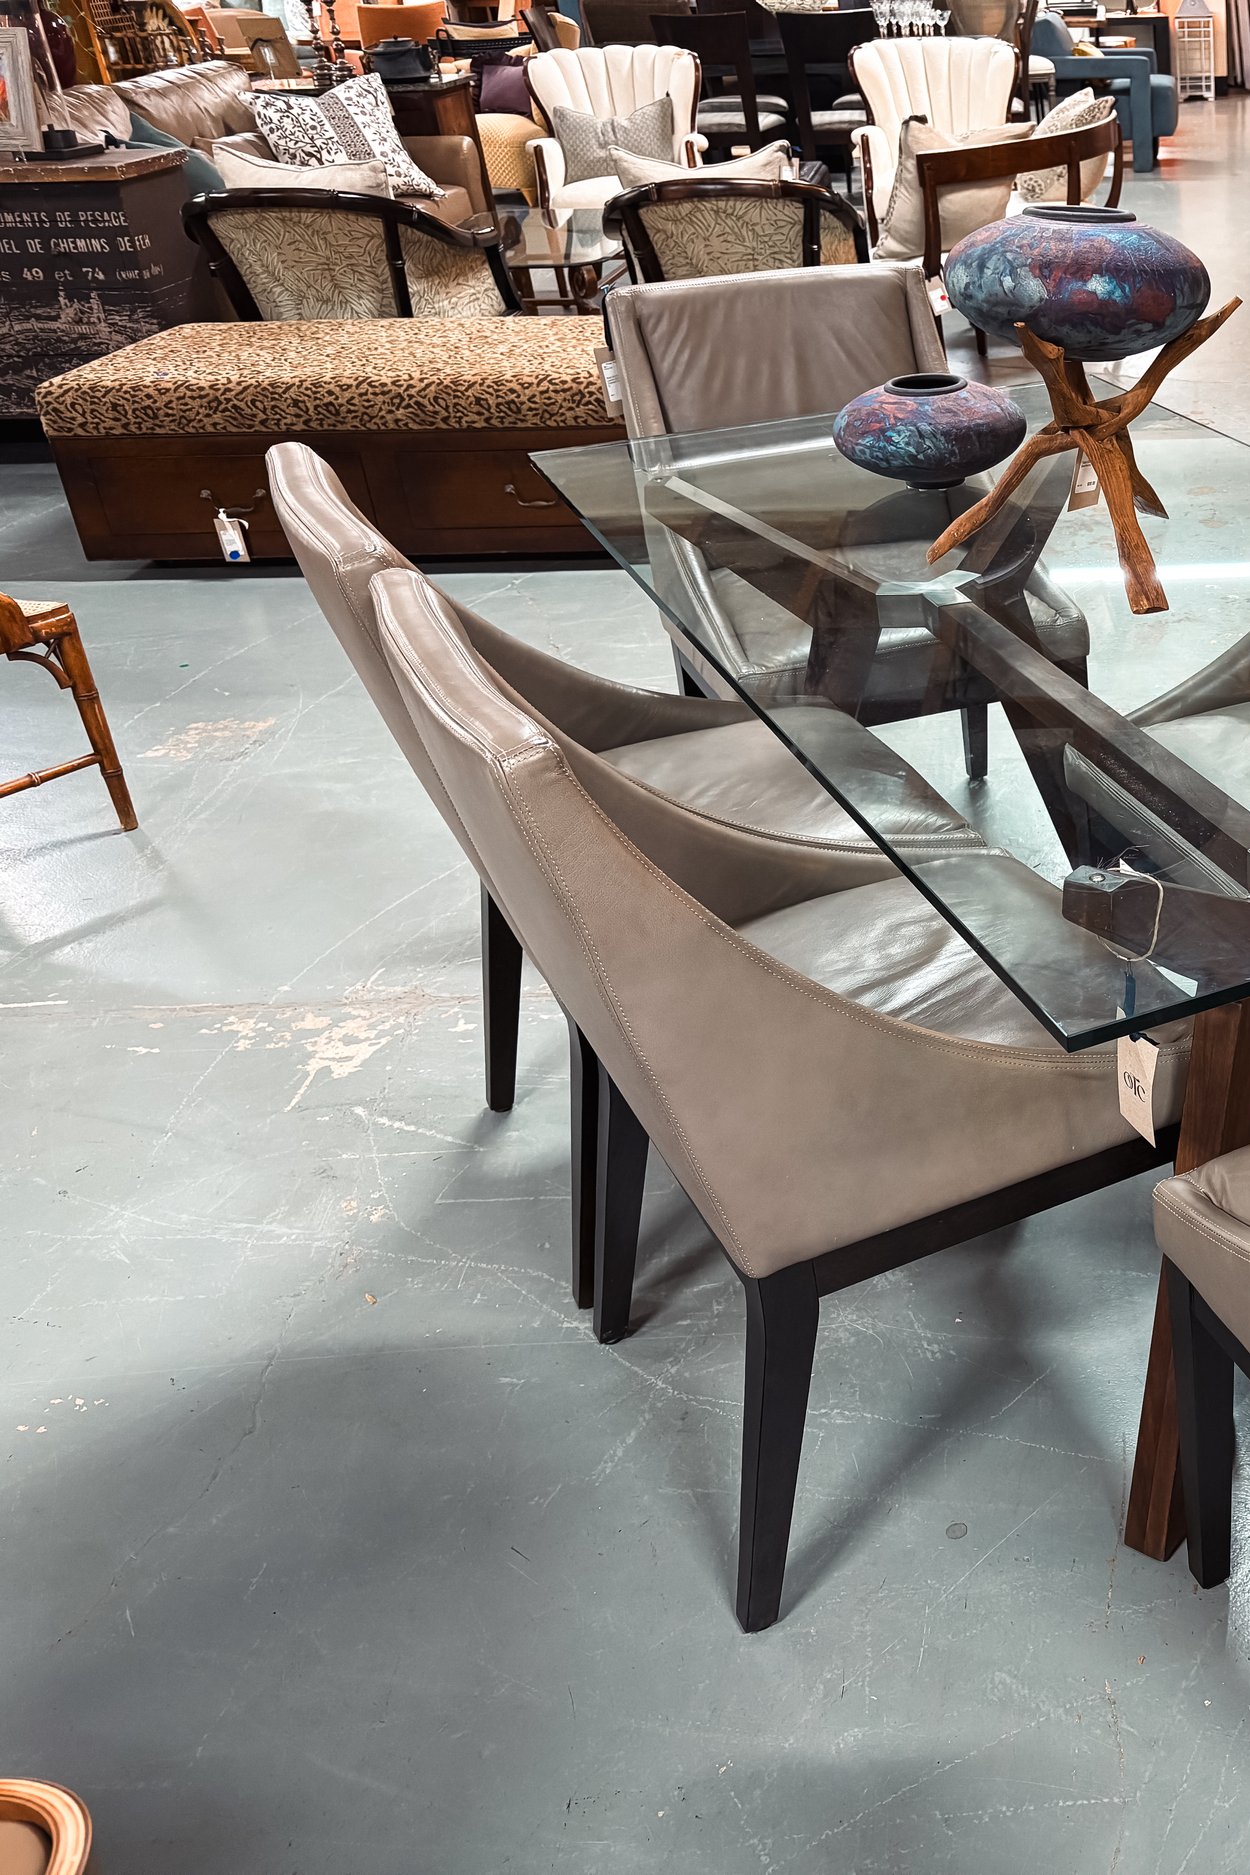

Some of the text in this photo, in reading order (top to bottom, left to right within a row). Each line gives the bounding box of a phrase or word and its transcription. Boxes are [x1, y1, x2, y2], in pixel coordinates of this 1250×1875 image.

[56, 212, 75, 228] DE
[78, 211, 129, 228] PESAGE
[25, 239, 45, 253] DE
[50, 238, 110, 254] CHEMINS
[117, 236, 134, 251] DE
[22, 267, 44, 281] 49
[54, 269, 74, 281] et
[82, 267, 106, 281] 74
